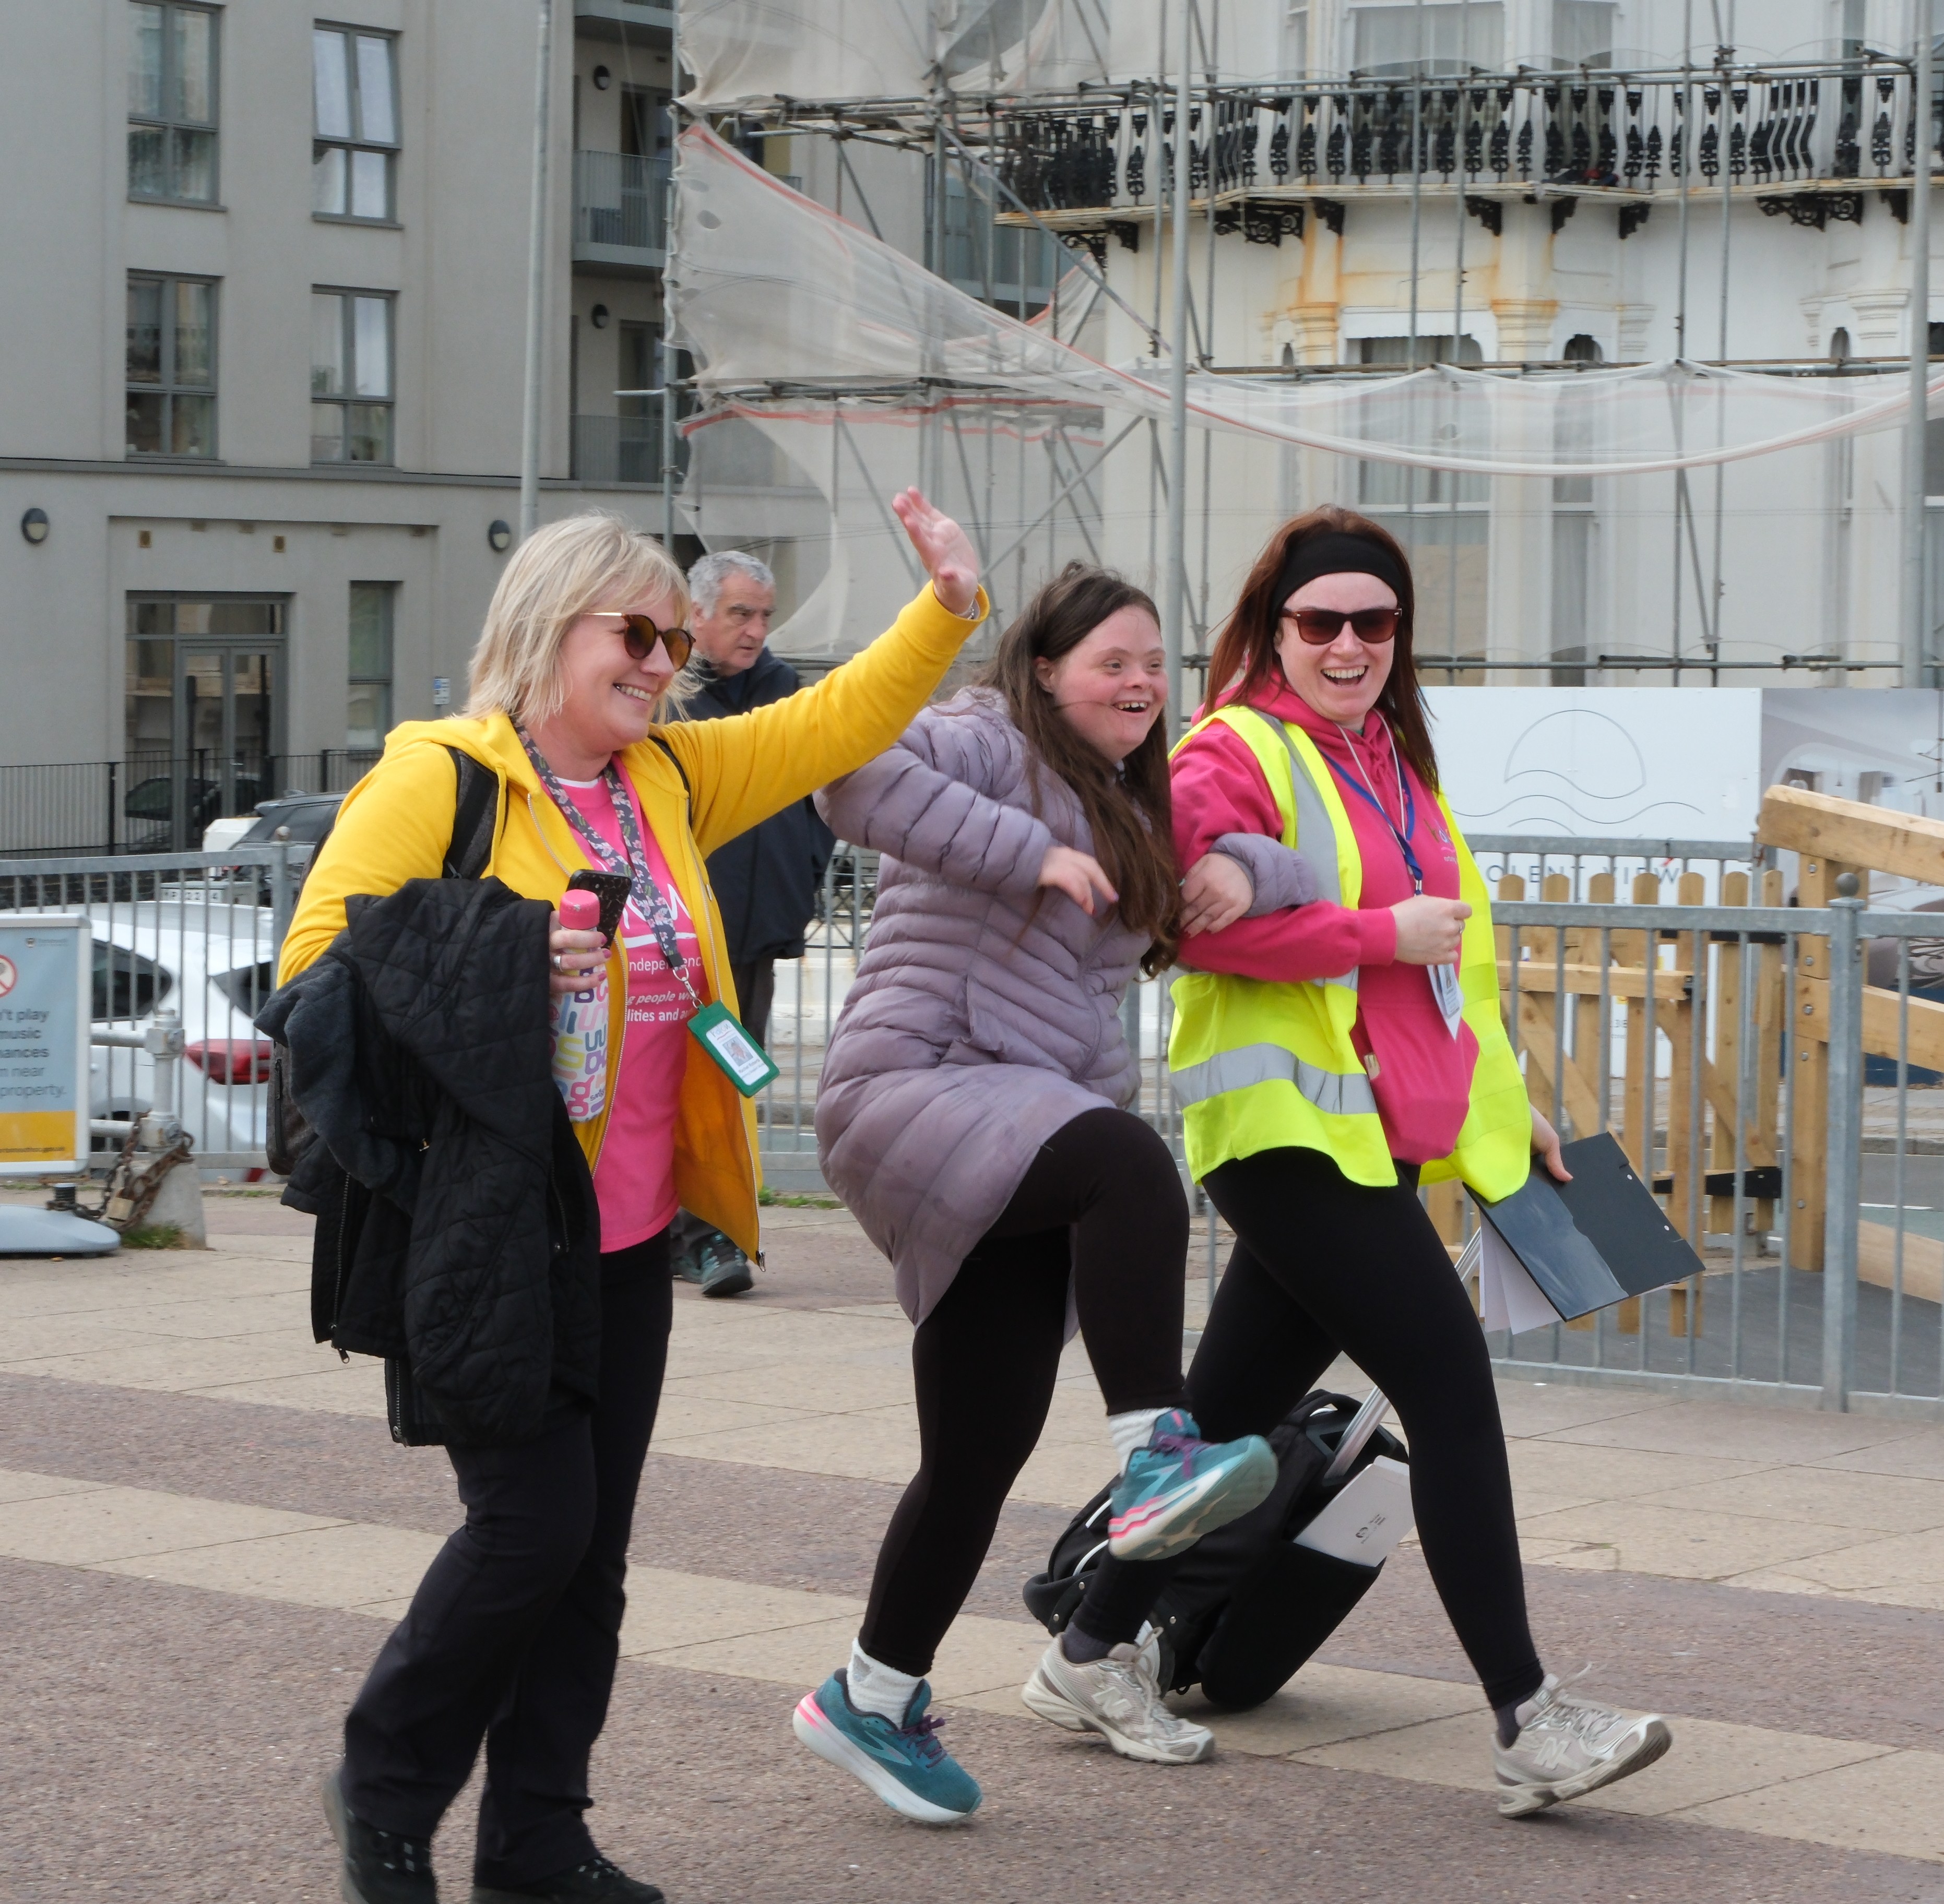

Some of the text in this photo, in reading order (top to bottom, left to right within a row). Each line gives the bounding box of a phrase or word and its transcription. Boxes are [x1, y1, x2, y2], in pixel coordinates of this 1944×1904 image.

[635, 991, 675, 1006] people
[16, 1008, 50, 1024] play
[658, 1008, 679, 1021] and
